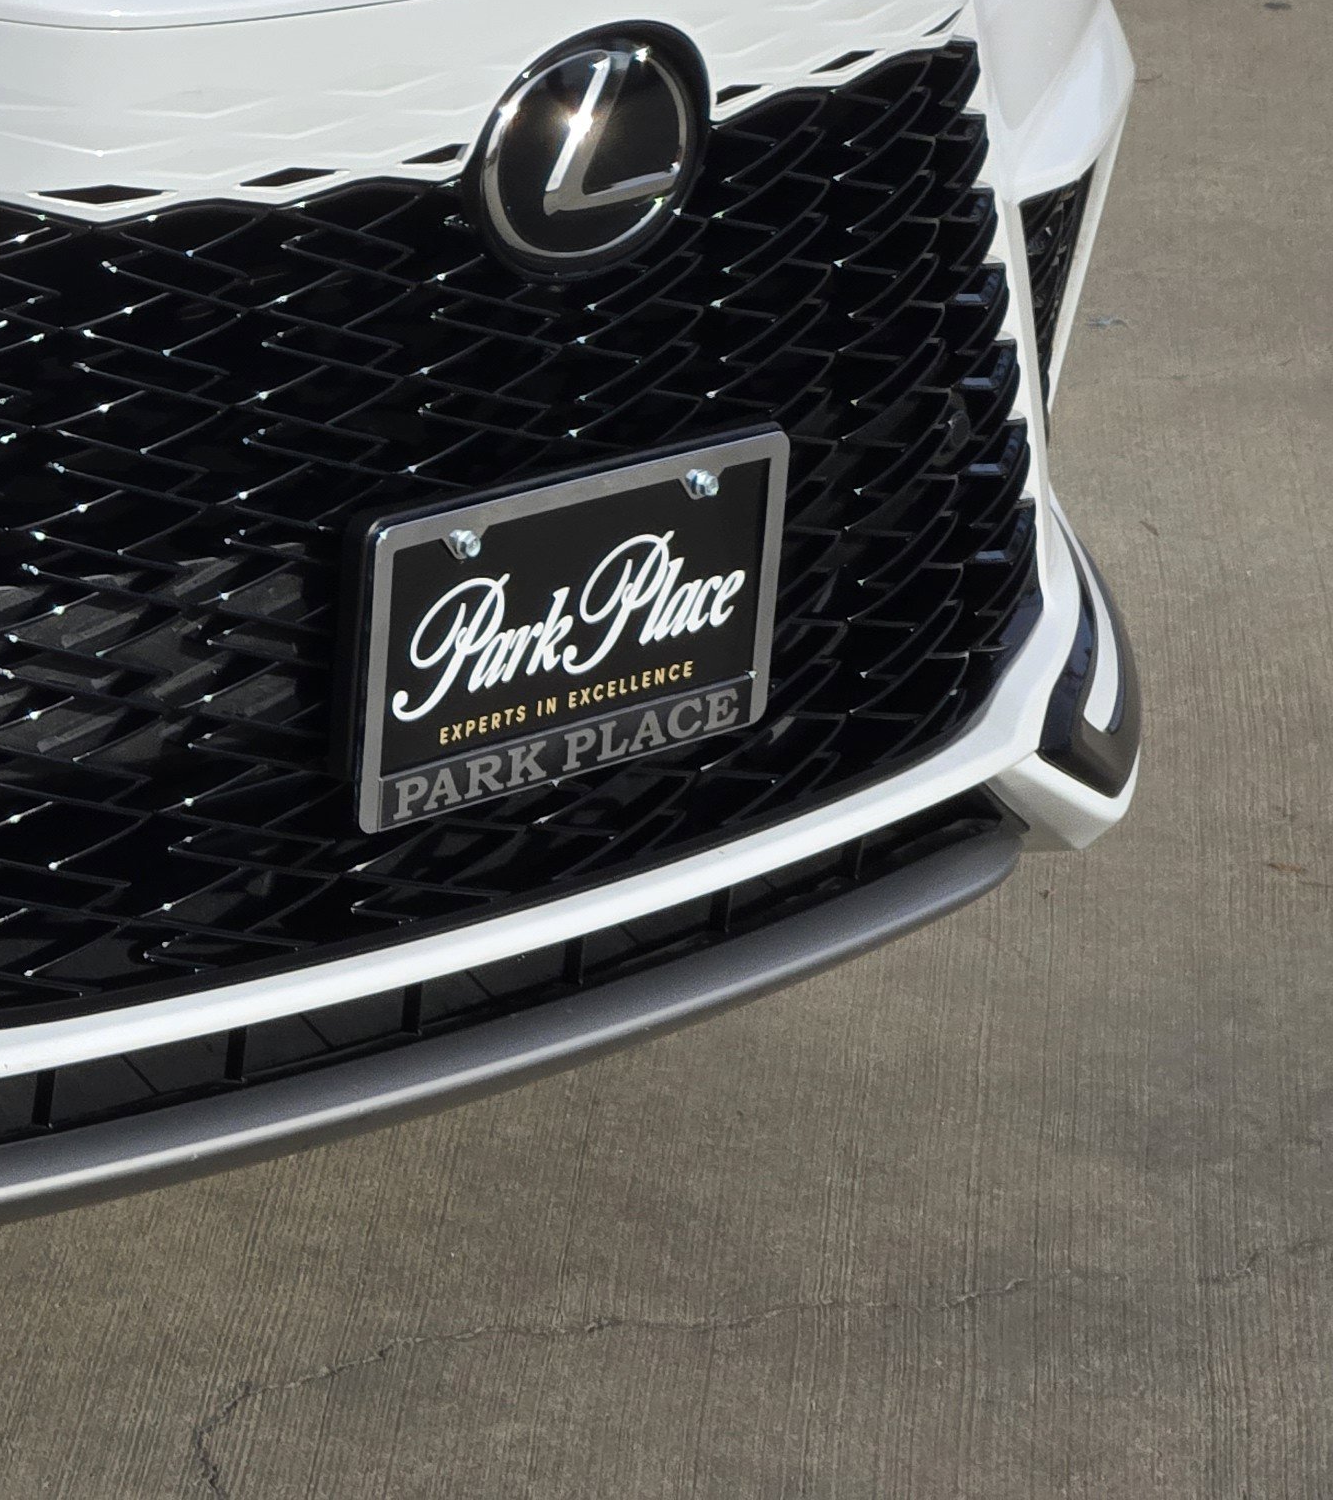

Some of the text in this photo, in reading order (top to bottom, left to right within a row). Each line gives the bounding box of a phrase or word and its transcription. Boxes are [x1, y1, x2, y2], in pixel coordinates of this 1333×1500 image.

[392, 530, 745, 721] Park Place
[393, 688, 739, 820] PARK PLACE
[439, 660, 694, 745] EXPERTS IN EXCELLENCE
